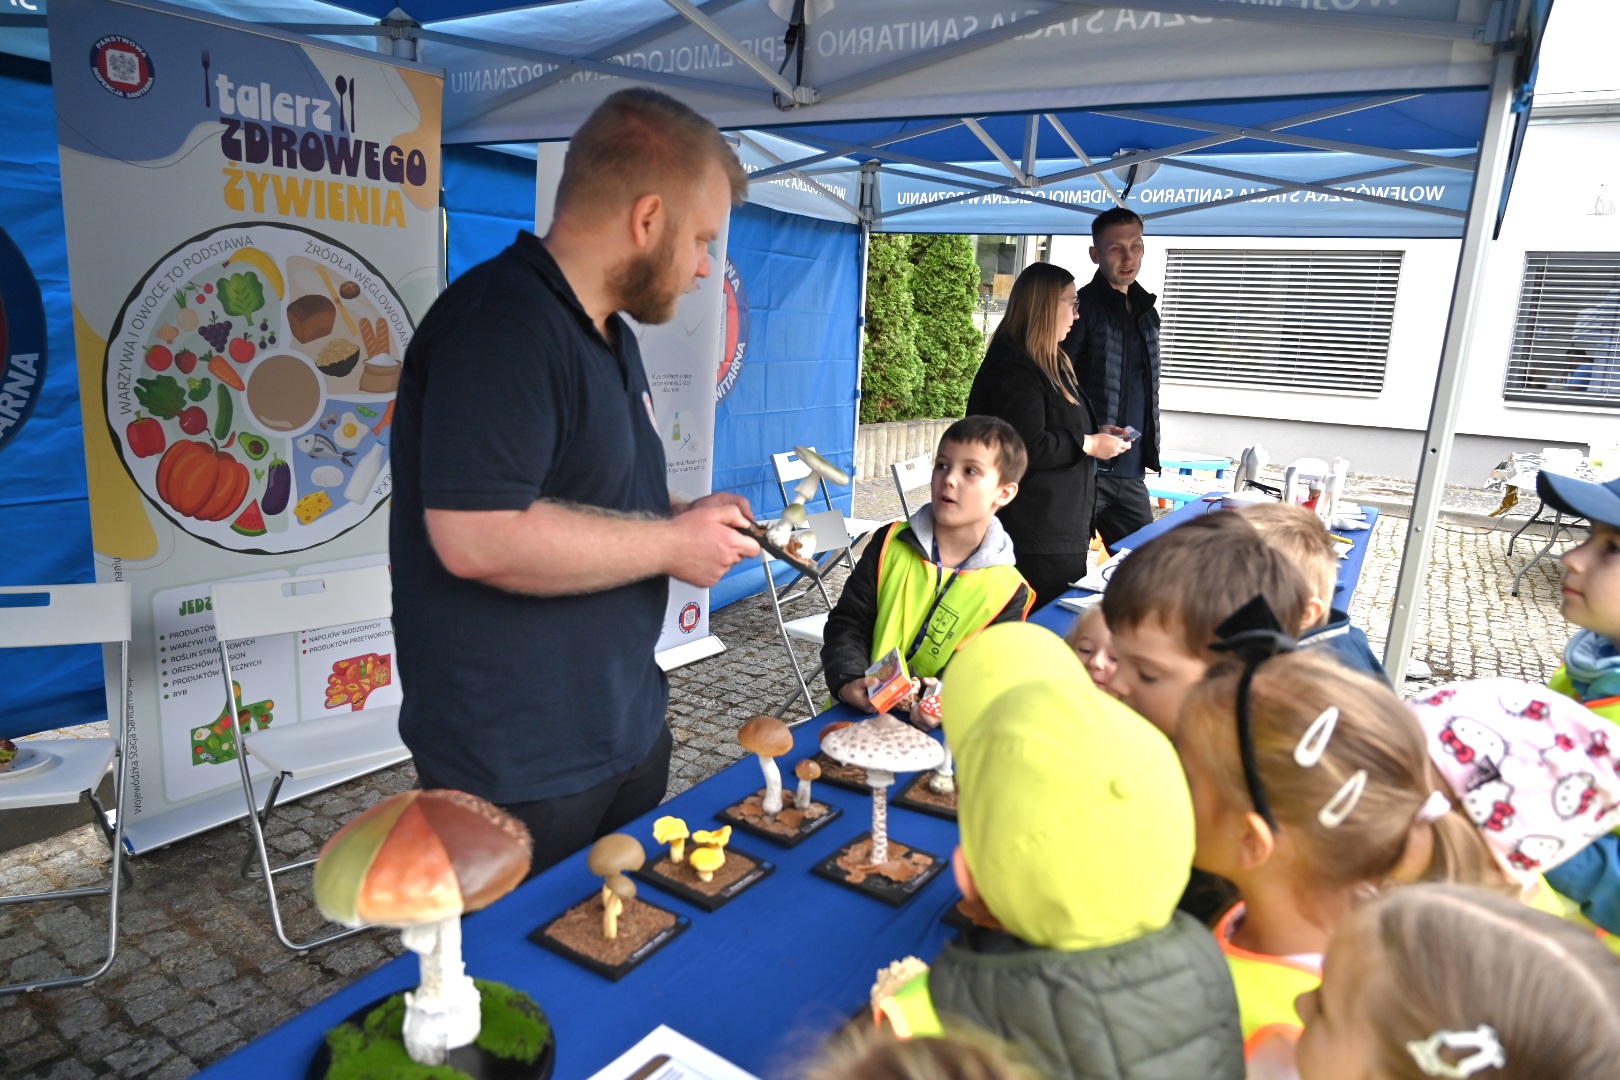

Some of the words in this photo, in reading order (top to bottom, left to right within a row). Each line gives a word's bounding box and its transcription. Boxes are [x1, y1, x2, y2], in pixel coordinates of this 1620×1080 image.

[215, 73, 332, 131] talerz
[219, 117, 427, 186] ZDROWEGO
[222, 161, 407, 228] ŻYWIENIA
[304, 240, 352, 274] ŹRÓDŁA
[117, 341, 138, 415] WARZYWA
[131, 280, 170, 331] OWOCE
[164, 265, 184, 283] TO
[182, 235, 254, 271] PODSTAWA
[178, 596, 213, 617] JEDZ
[169, 638, 204, 651] WARZYW
[308, 630, 341, 643] NAPOJÓW
[341, 622, 381, 636] SŁODZONYCH
[170, 651, 198, 663] ROŚLIN
[198, 638, 256, 656] STRĄCKOWYCH
[309, 639, 349, 654] PRODUKTÓW
[171, 659, 214, 675] ORZECHÓW
[172, 669, 220, 687] PRODUKTÓW
[221, 659, 262, 675] ECZNYCH
[173, 688, 188, 698] RYB
[129, 760, 144, 815] Wojewódzka
